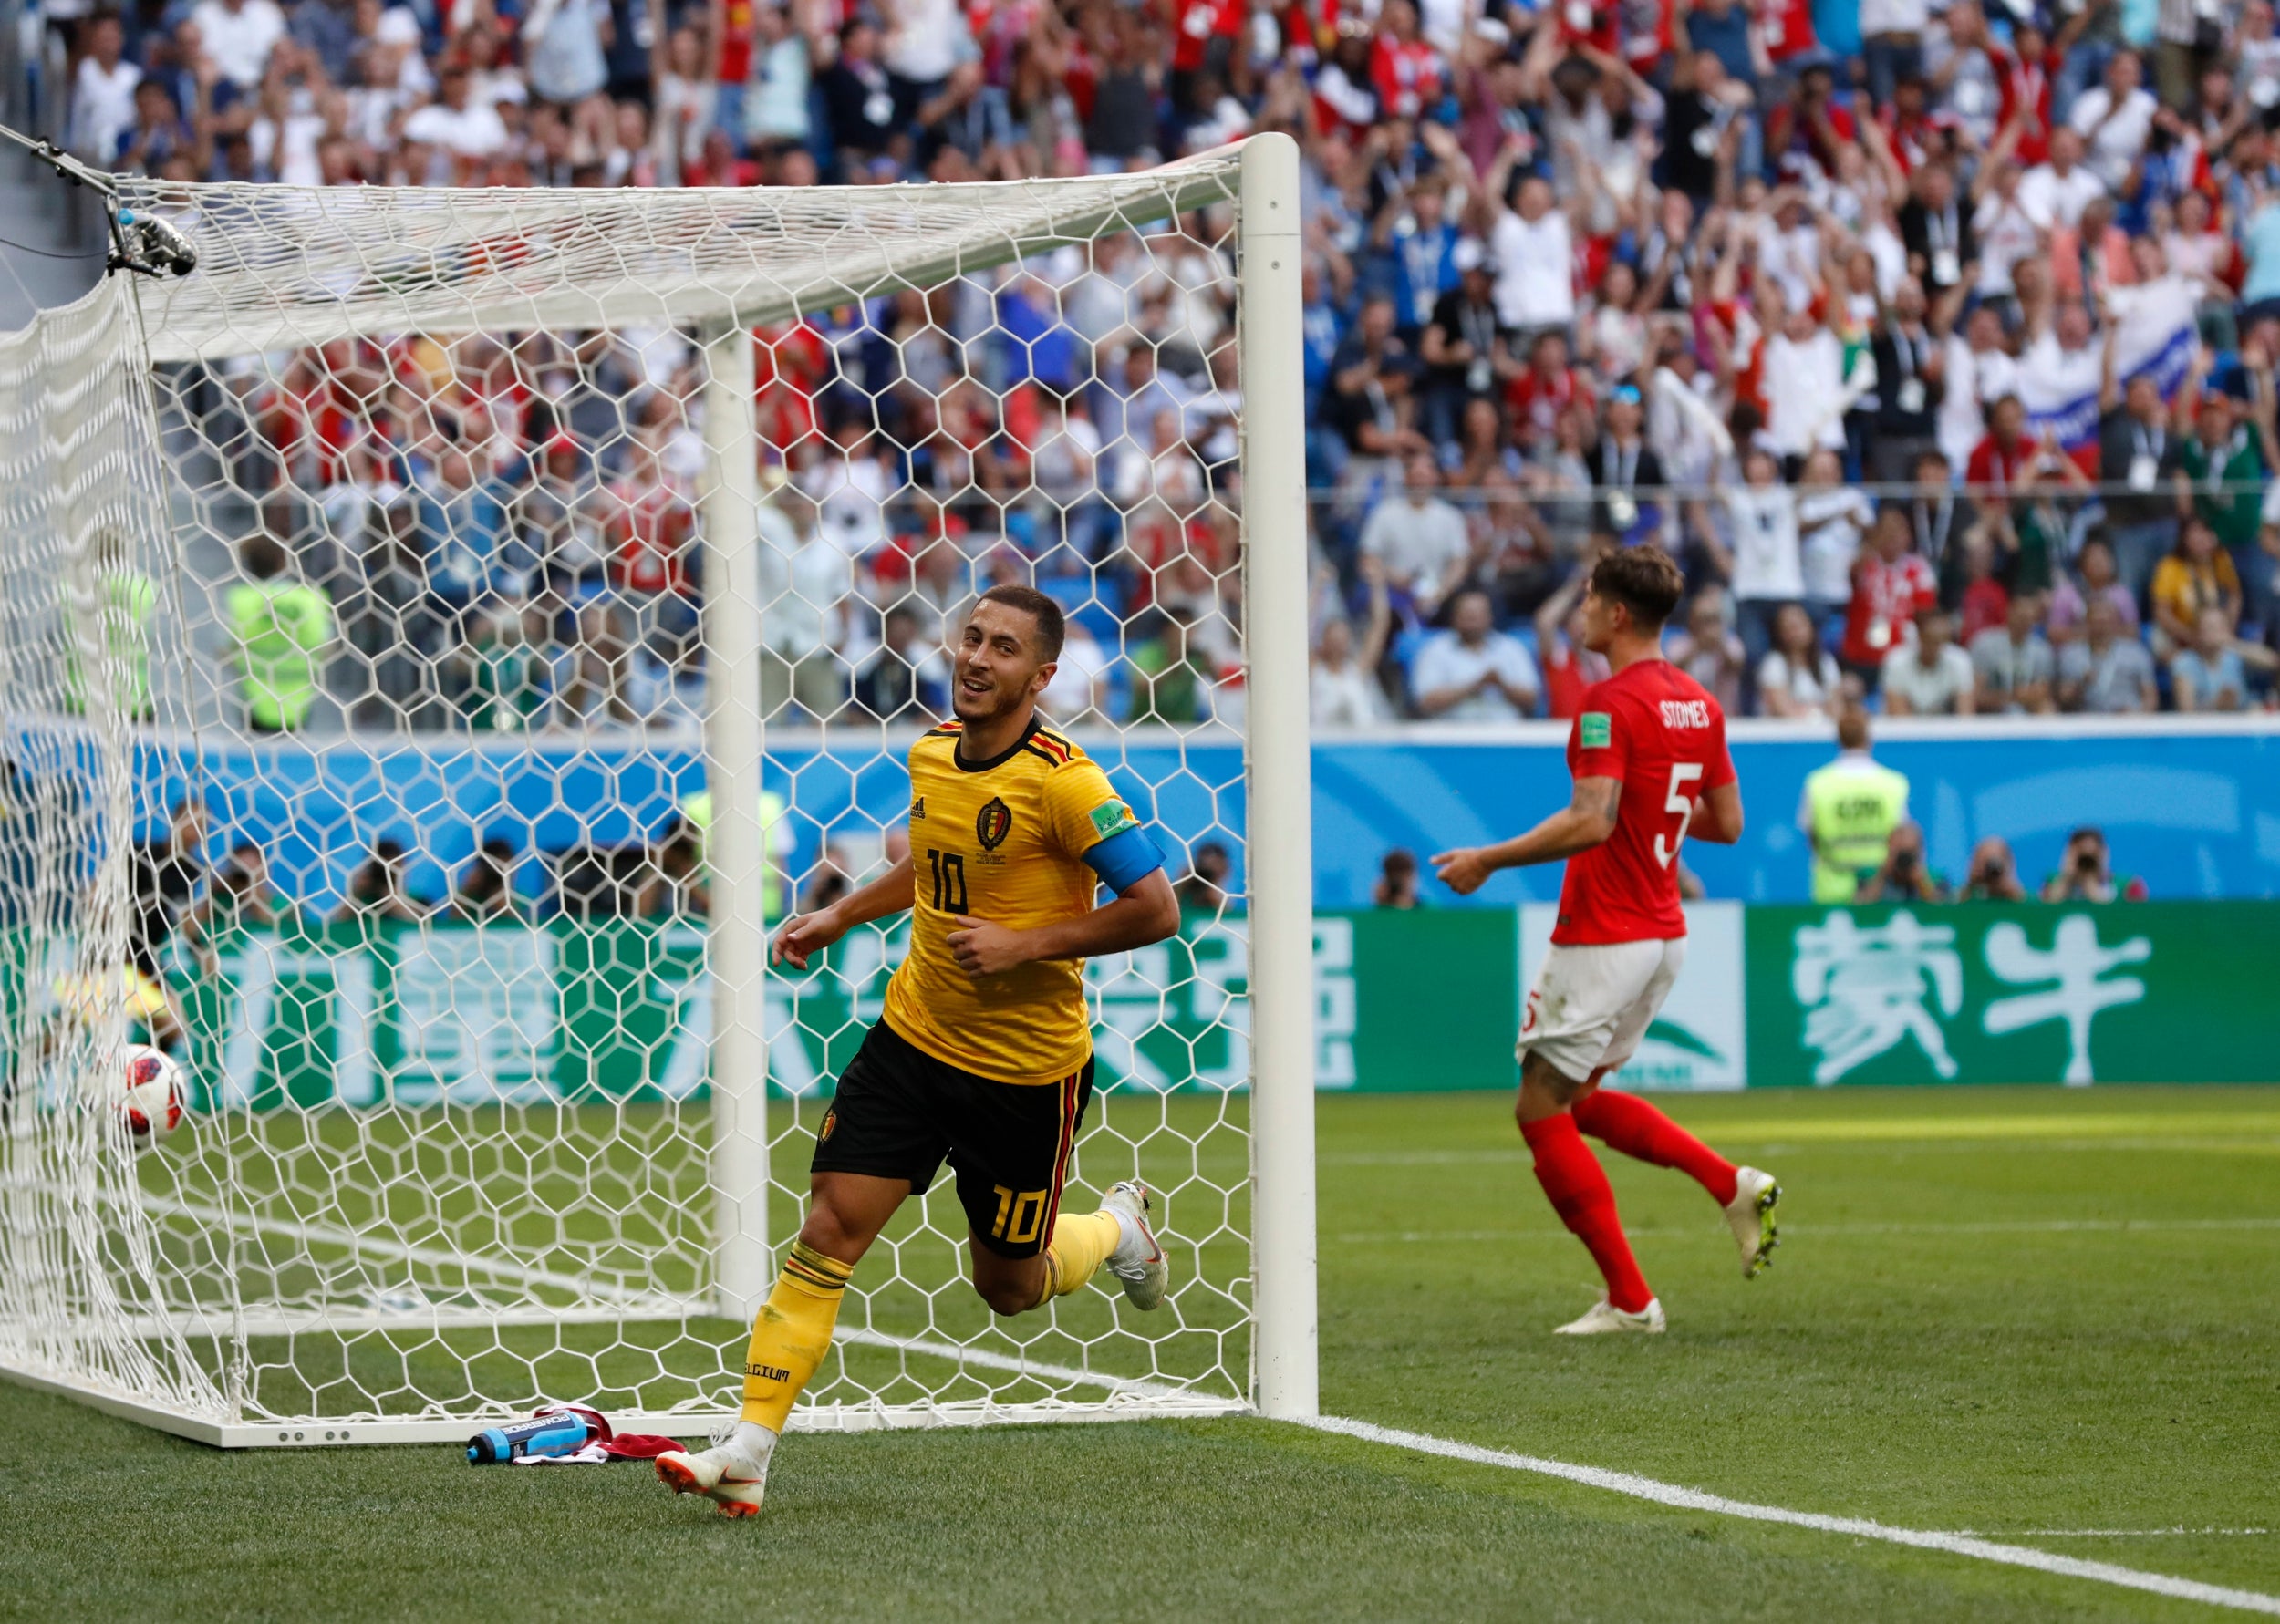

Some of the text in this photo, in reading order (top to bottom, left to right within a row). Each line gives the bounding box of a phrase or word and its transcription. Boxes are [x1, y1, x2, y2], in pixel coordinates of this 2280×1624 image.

[1660, 700, 1710, 729] STONES
[1653, 763, 1704, 871] 5
[927, 848, 969, 915] 10
[1791, 909, 2152, 1086] 蒙牛
[991, 1184, 1047, 1243] 10
[502, 1413, 571, 1434] POWERADE
